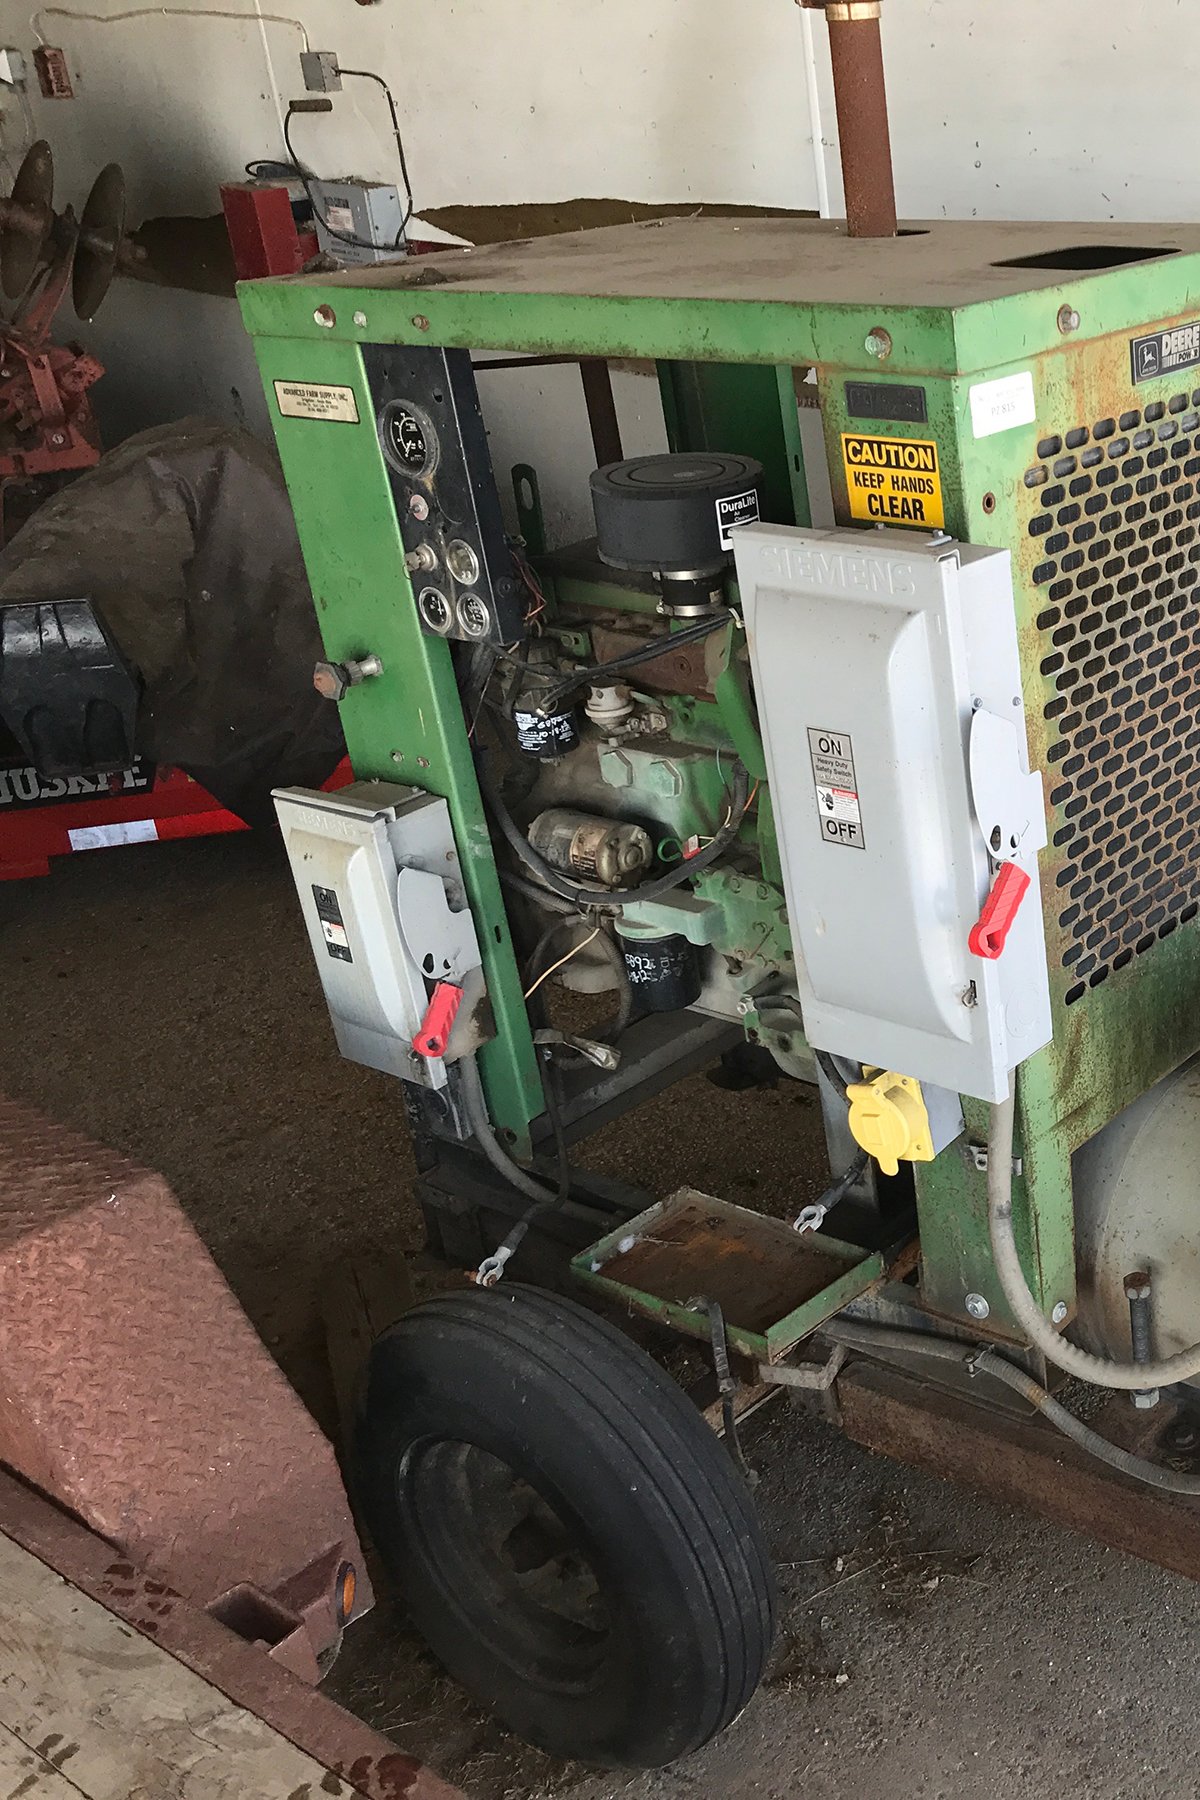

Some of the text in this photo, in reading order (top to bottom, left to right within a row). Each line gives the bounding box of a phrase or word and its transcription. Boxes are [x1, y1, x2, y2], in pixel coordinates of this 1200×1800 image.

[1161, 325, 1200, 357] DEERE
[1178, 348, 1198, 362] POWR
[283, 388, 305, 397] ADVANCED
[306, 390, 318, 398] FARM
[848, 441, 933, 470] CAUTION
[853, 471, 934, 495] KEEP HANDS
[720, 496, 755, 513] DuraLite
[867, 493, 925, 521] CLEAR
[760, 544, 916, 595] SIEMENS
[818, 737, 842, 756] ON
[815, 765, 852, 778] Safety Switch
[817, 757, 848, 770] Heavy Duty
[826, 819, 856, 839] OFF
[319, 893, 332, 904] ON
